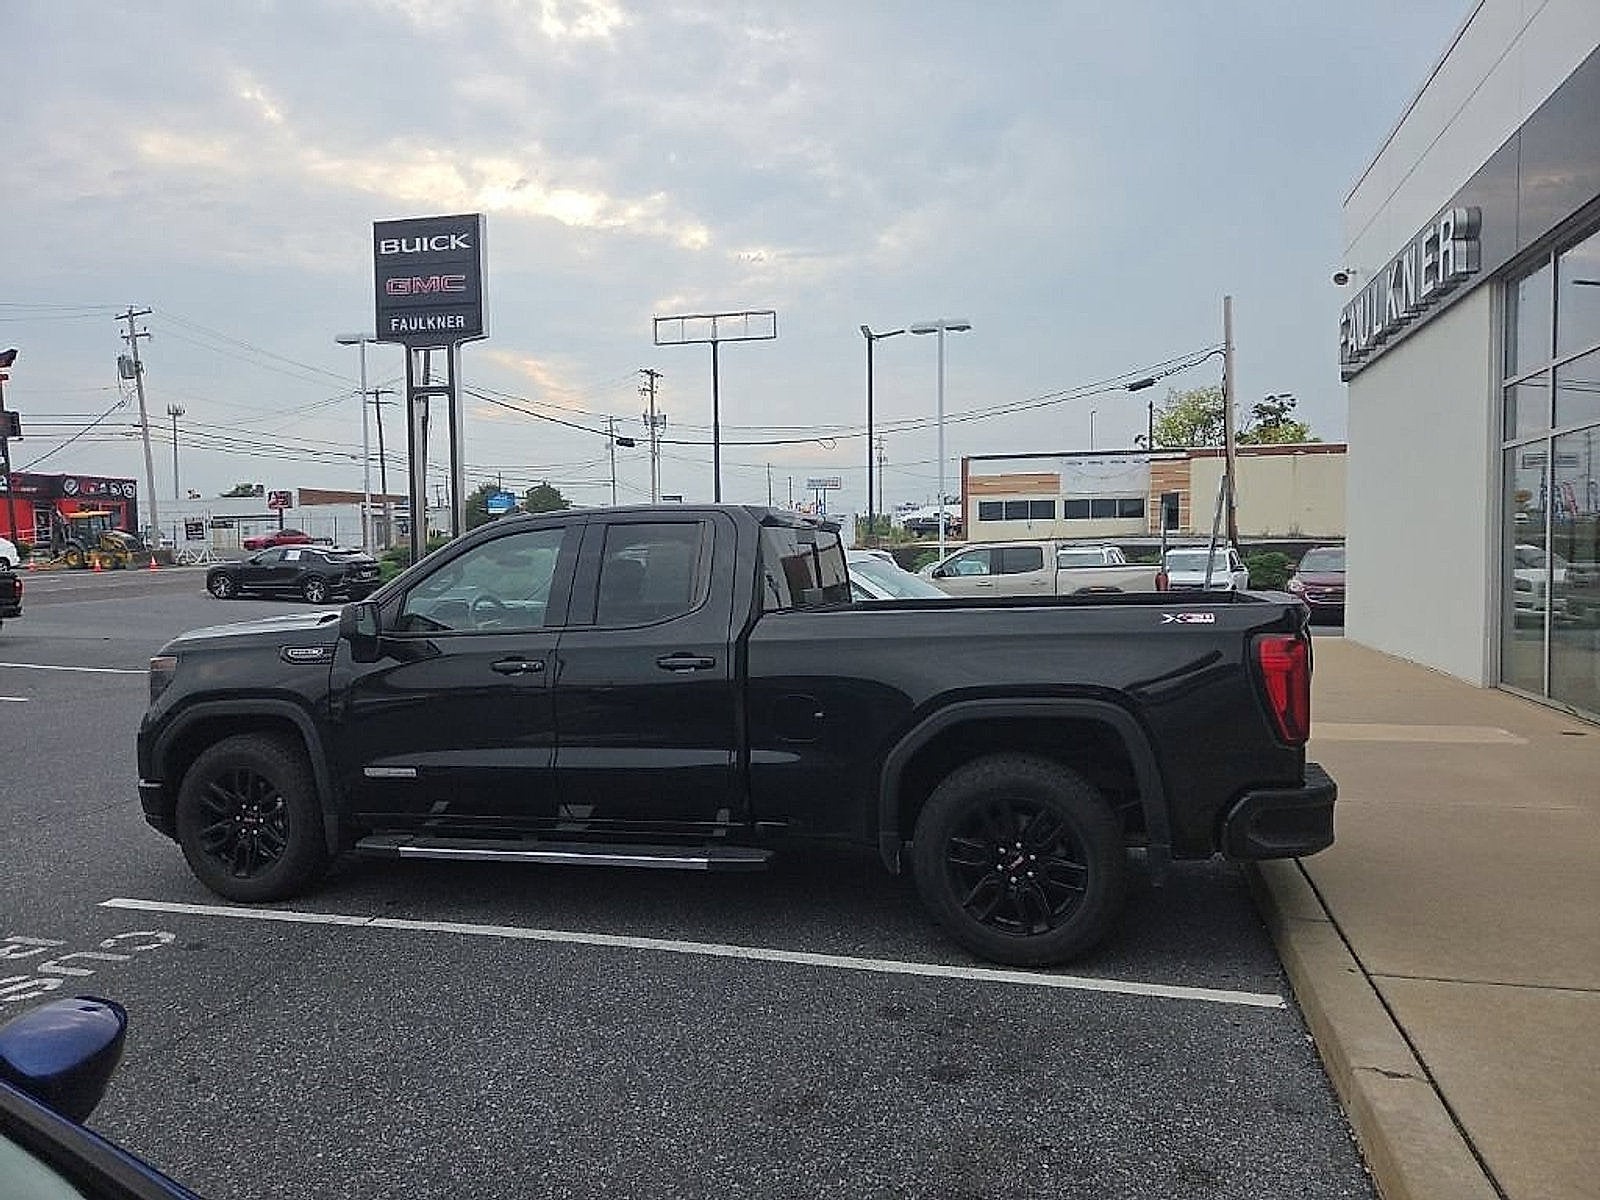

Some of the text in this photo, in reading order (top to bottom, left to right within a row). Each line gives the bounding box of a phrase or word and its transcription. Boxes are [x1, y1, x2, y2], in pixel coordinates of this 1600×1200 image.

[380, 234, 472, 254] BUICK
[386, 275, 466, 295] GMC
[391, 315, 465, 330] FAULKNER
